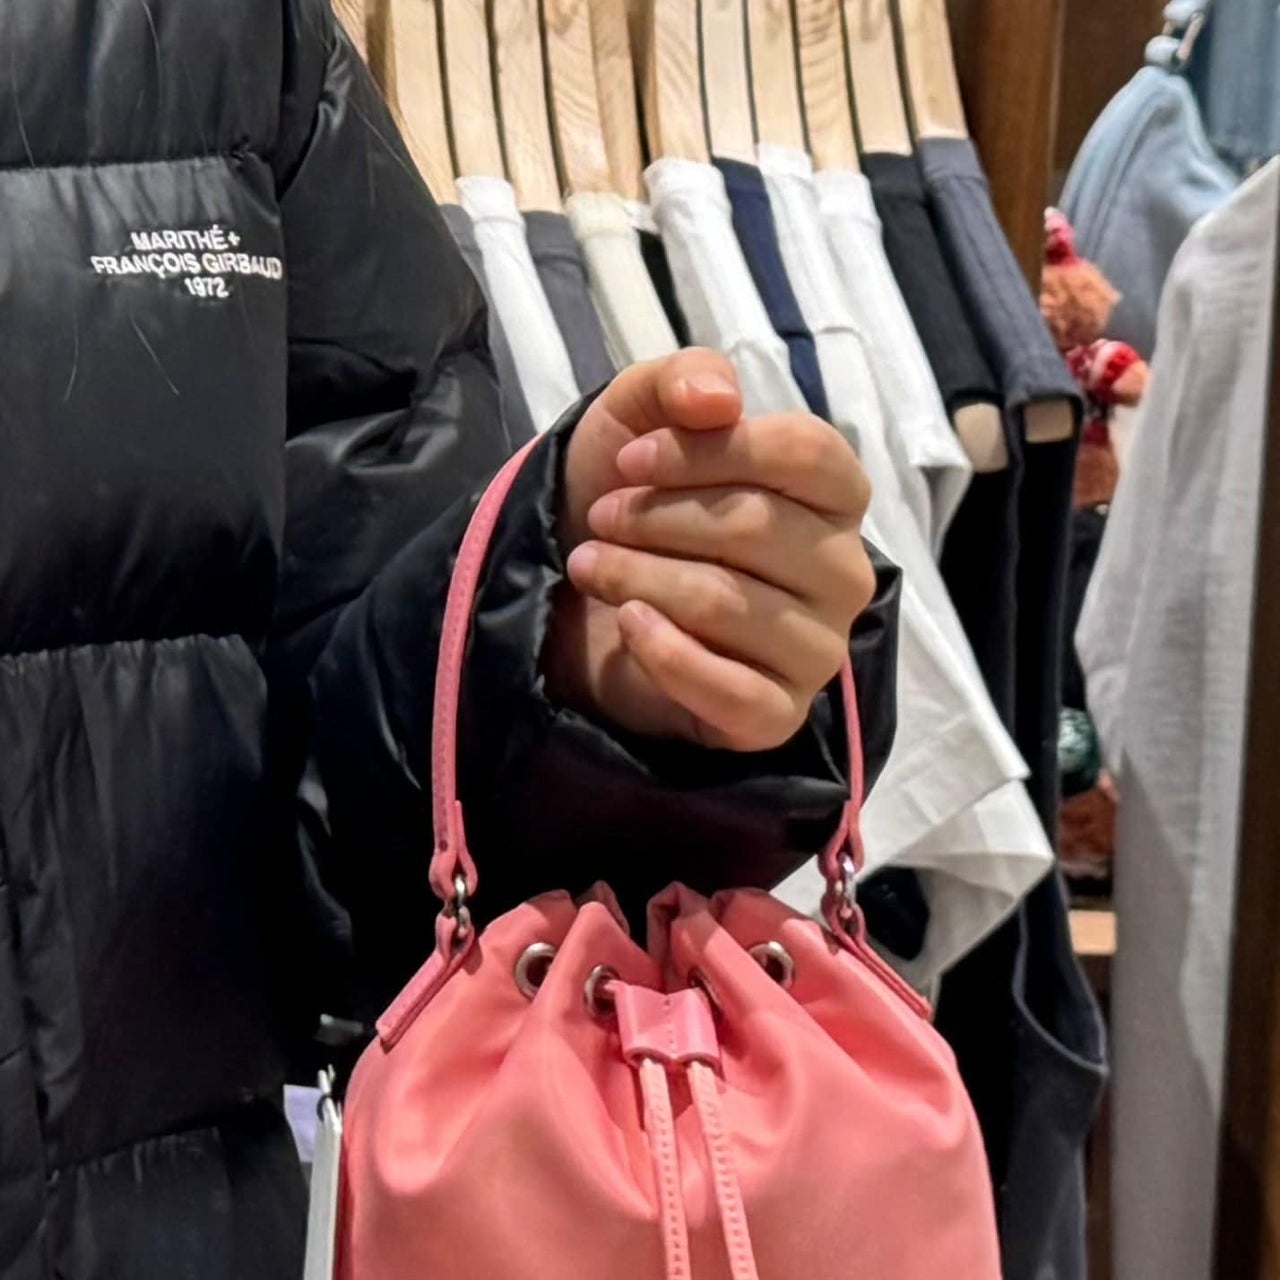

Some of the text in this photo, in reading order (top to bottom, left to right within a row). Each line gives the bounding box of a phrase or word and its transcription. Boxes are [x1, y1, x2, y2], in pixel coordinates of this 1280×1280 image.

[90, 252, 283, 280] FRANÇOIS GIRBAUD
[184, 276, 229, 299] 1972
